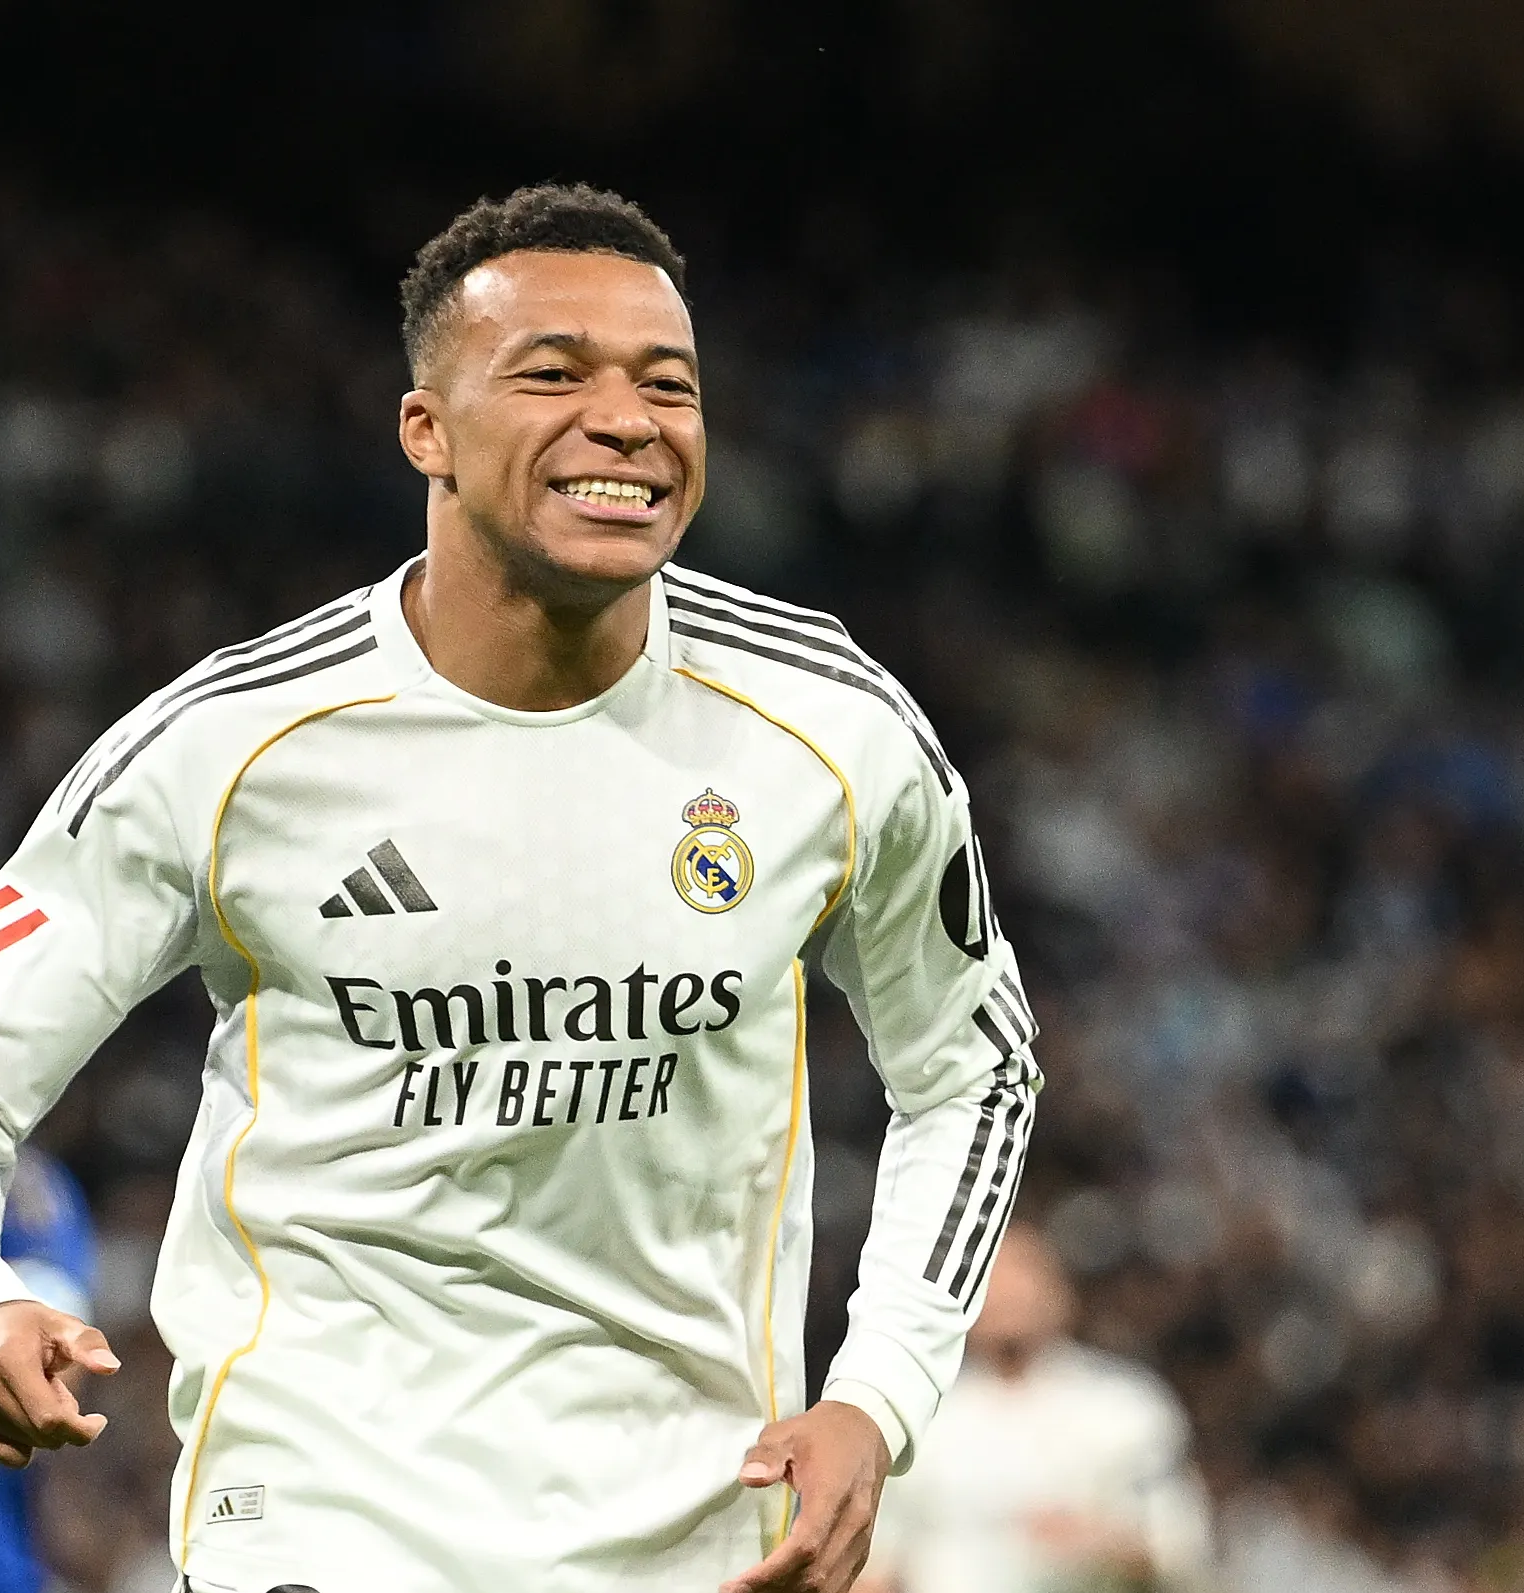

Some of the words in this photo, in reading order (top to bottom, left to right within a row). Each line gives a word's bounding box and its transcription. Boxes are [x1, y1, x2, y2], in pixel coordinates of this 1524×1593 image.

[324, 959, 743, 1052] Emirates
[392, 1060, 480, 1128] FLY
[496, 1052, 679, 1128] BETTER
